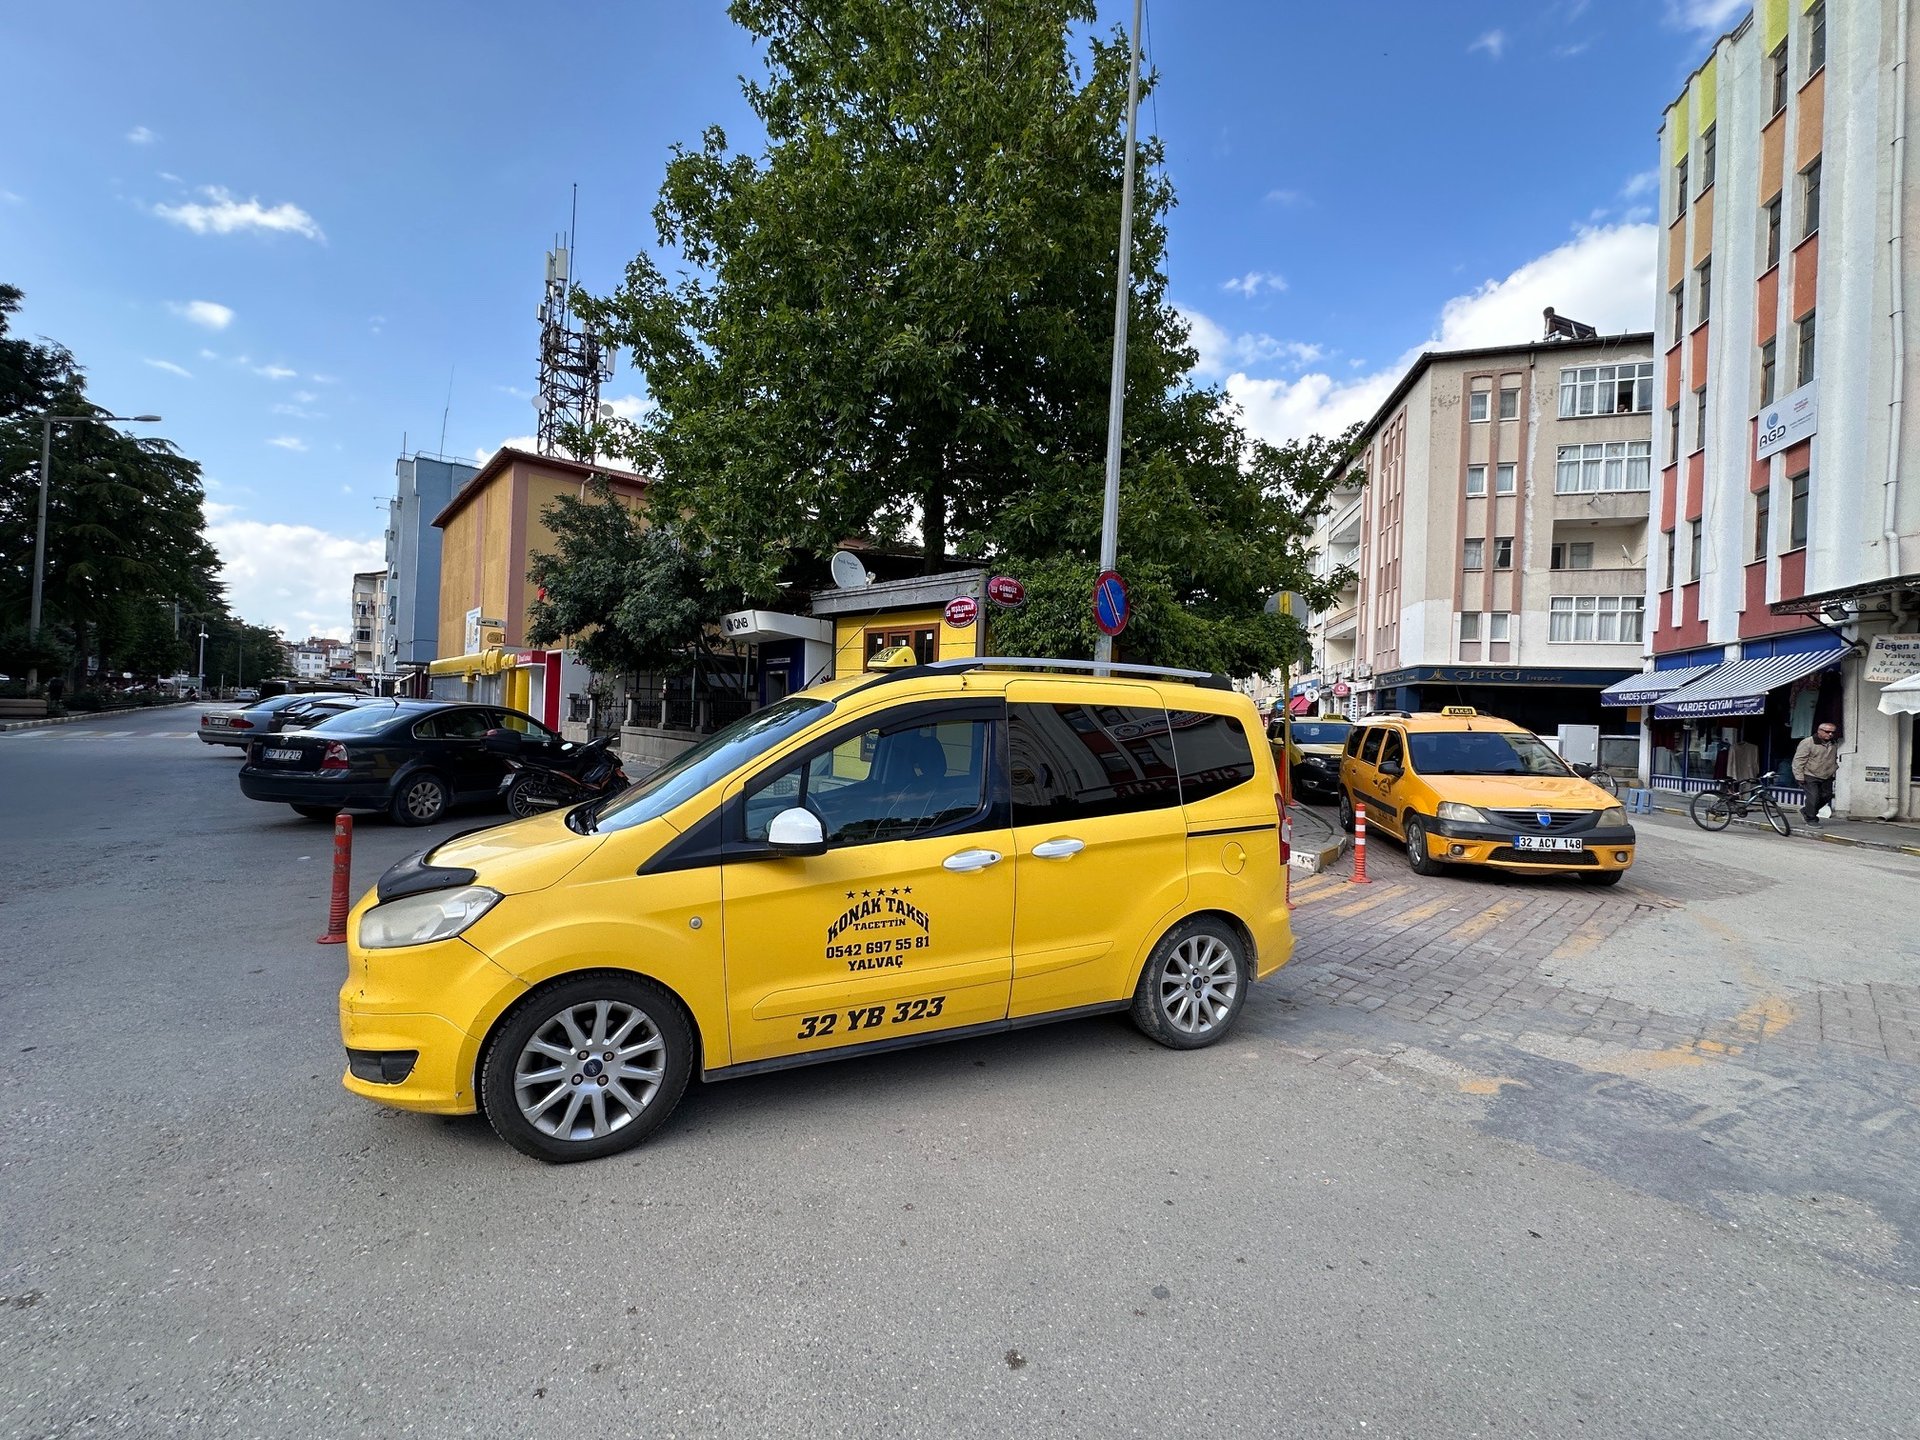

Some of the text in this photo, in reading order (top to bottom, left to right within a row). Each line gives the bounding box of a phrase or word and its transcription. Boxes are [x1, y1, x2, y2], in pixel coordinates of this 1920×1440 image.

[1760, 425, 1786, 447] AGD
[733, 617, 748, 629] QNB
[1677, 701, 1708, 712] KARDEŞ
[1520, 838, 1581, 849] 32 ACV 148
[827, 897, 930, 944] KONAK TAKSİ
[853, 917, 906, 931] TACETTİN
[826, 936, 929, 958] 0542 697 55 81
[848, 955, 903, 971] YALVAÇ
[797, 996, 946, 1039] 32 YB 323
